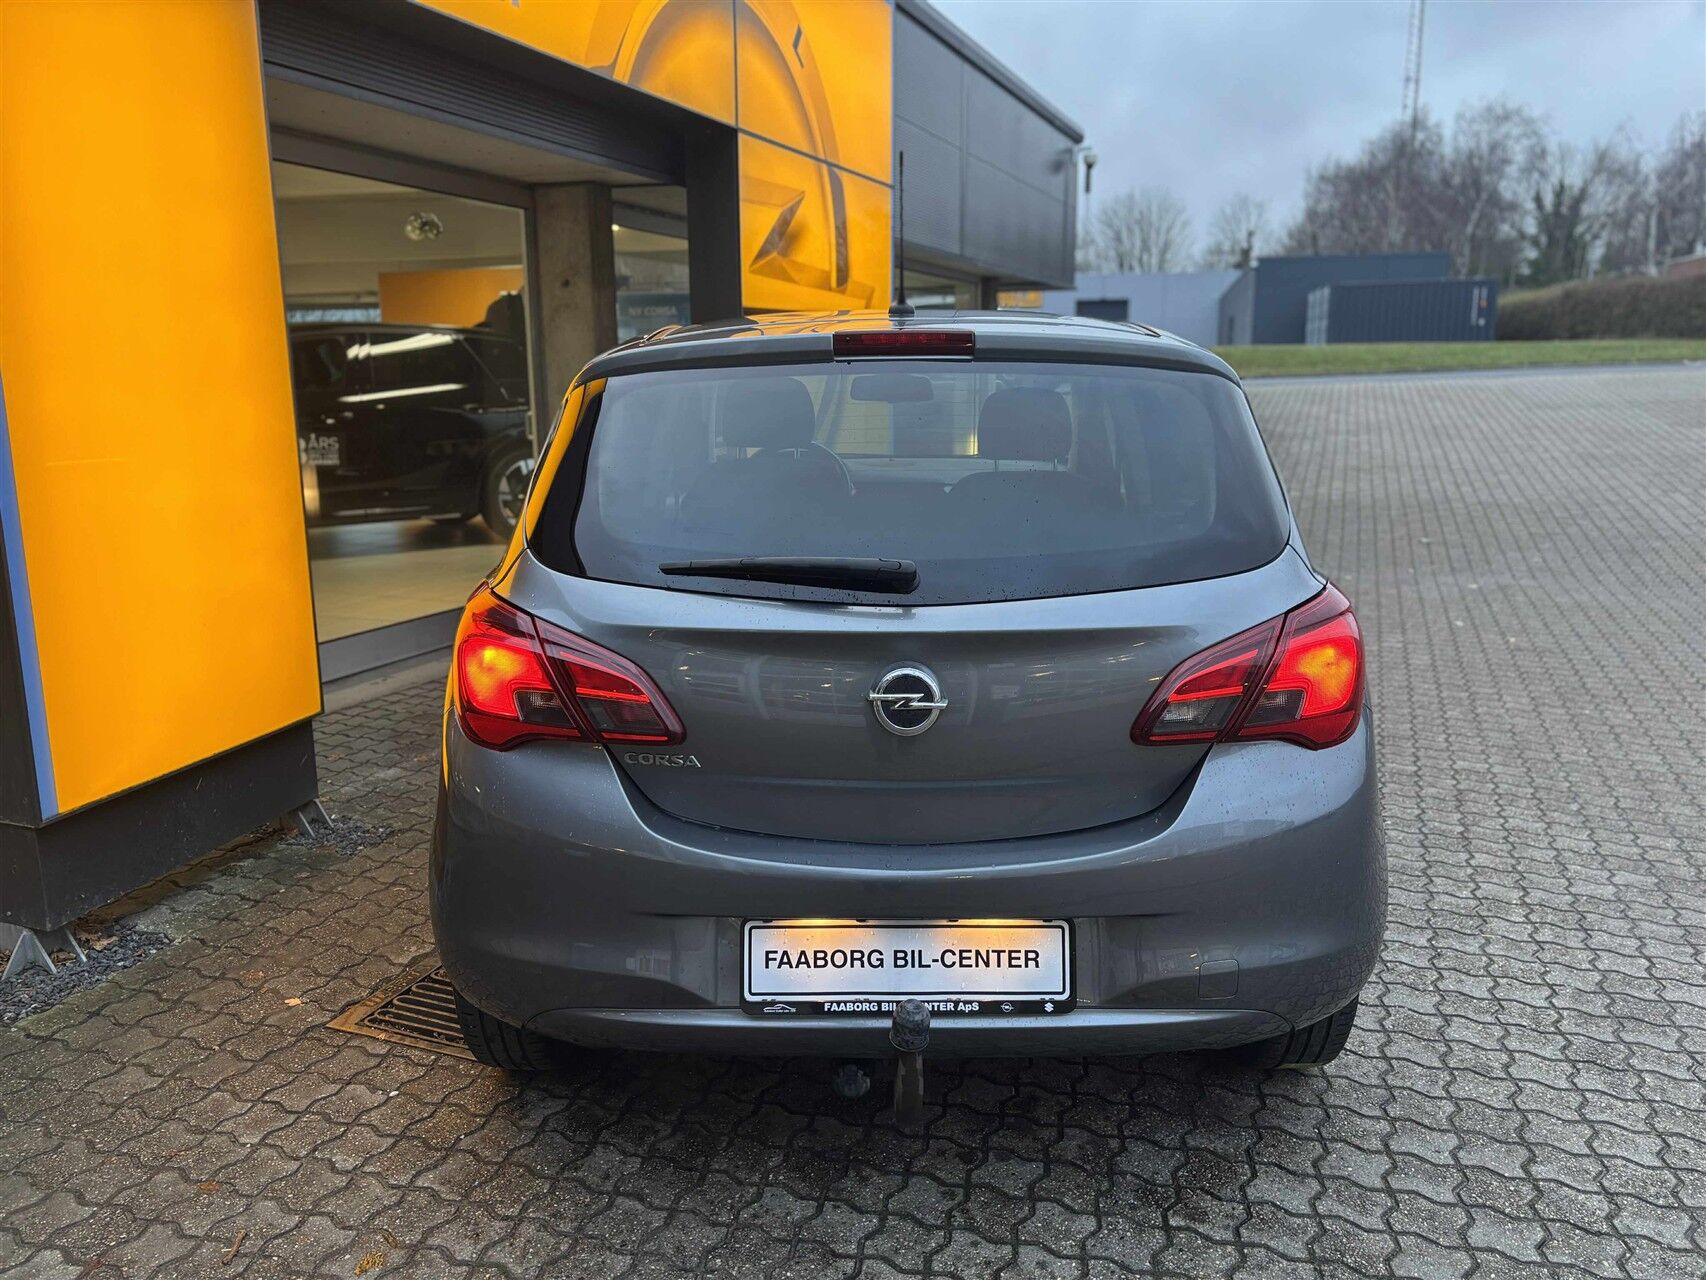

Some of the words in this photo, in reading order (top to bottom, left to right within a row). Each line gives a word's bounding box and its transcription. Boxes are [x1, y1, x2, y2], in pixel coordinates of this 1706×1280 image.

[624, 752, 701, 768] CORSA
[764, 949, 885, 969] FAABORG
[893, 949, 1041, 969] BIL-CENTER
[824, 1002, 878, 1012] FAABORG
[881, 1002, 955, 1011] BINTER
[957, 1002, 979, 1013] ApS
